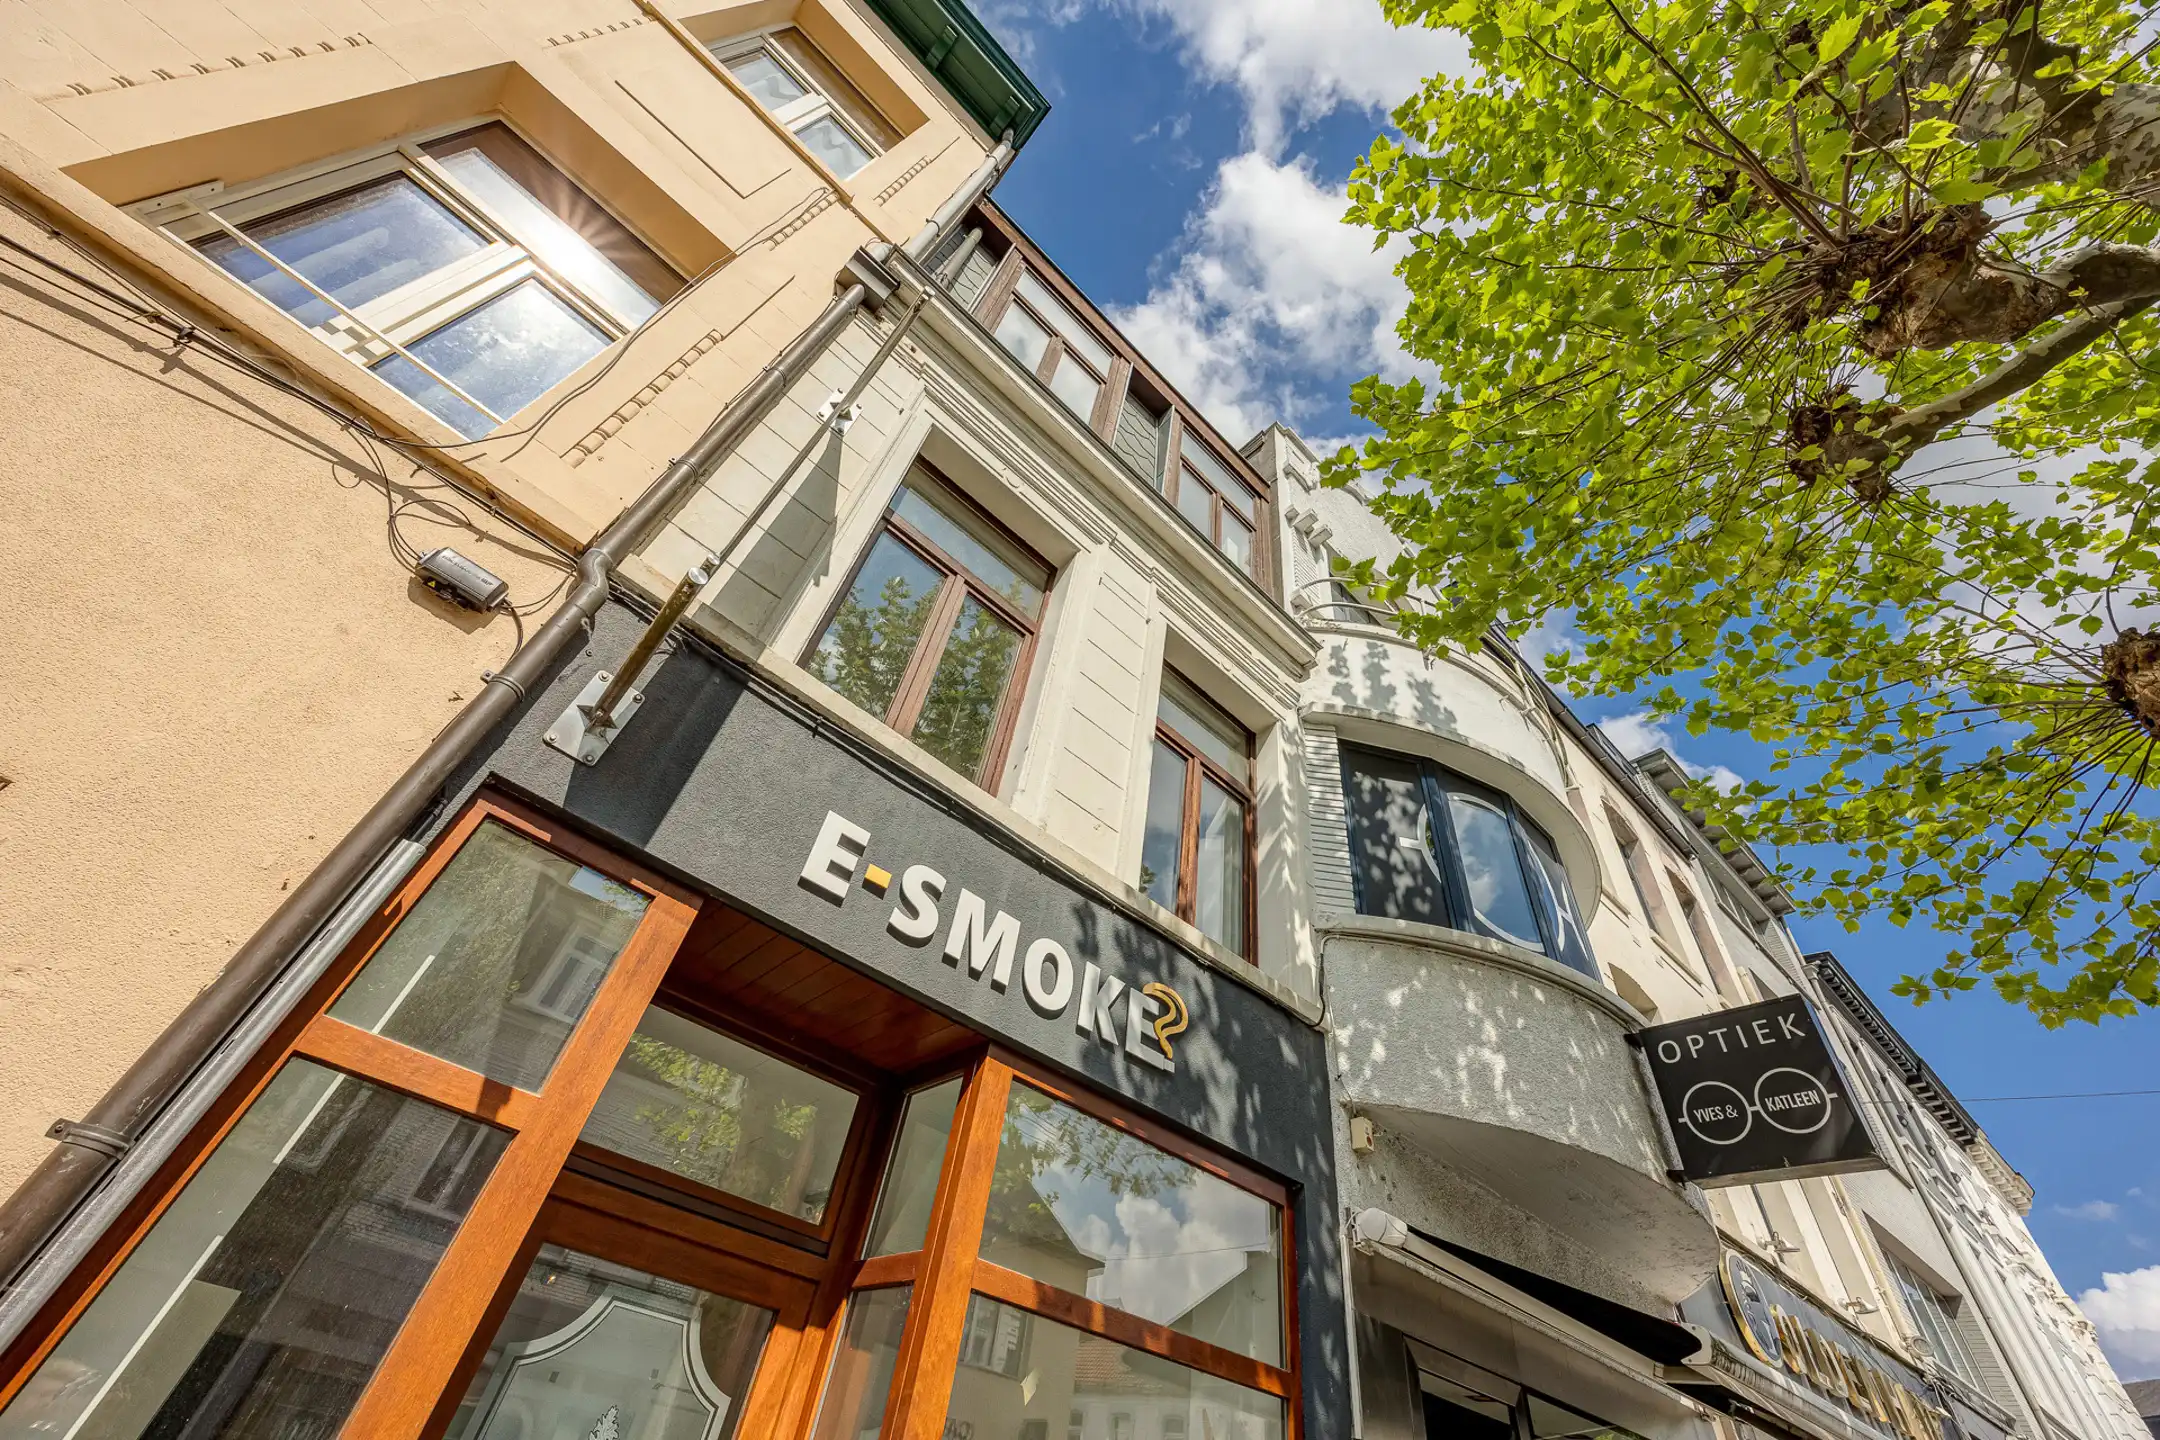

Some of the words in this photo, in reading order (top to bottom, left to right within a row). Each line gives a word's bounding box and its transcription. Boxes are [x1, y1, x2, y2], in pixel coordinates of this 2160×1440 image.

[800, 810, 1176, 1073] E-SMOKE
[1657, 1012, 1806, 1064] OPTIEK
[1693, 1106, 1724, 1123] YVES
[1726, 1104, 1739, 1118] &
[1764, 1089, 1821, 1112] KATLEEN
